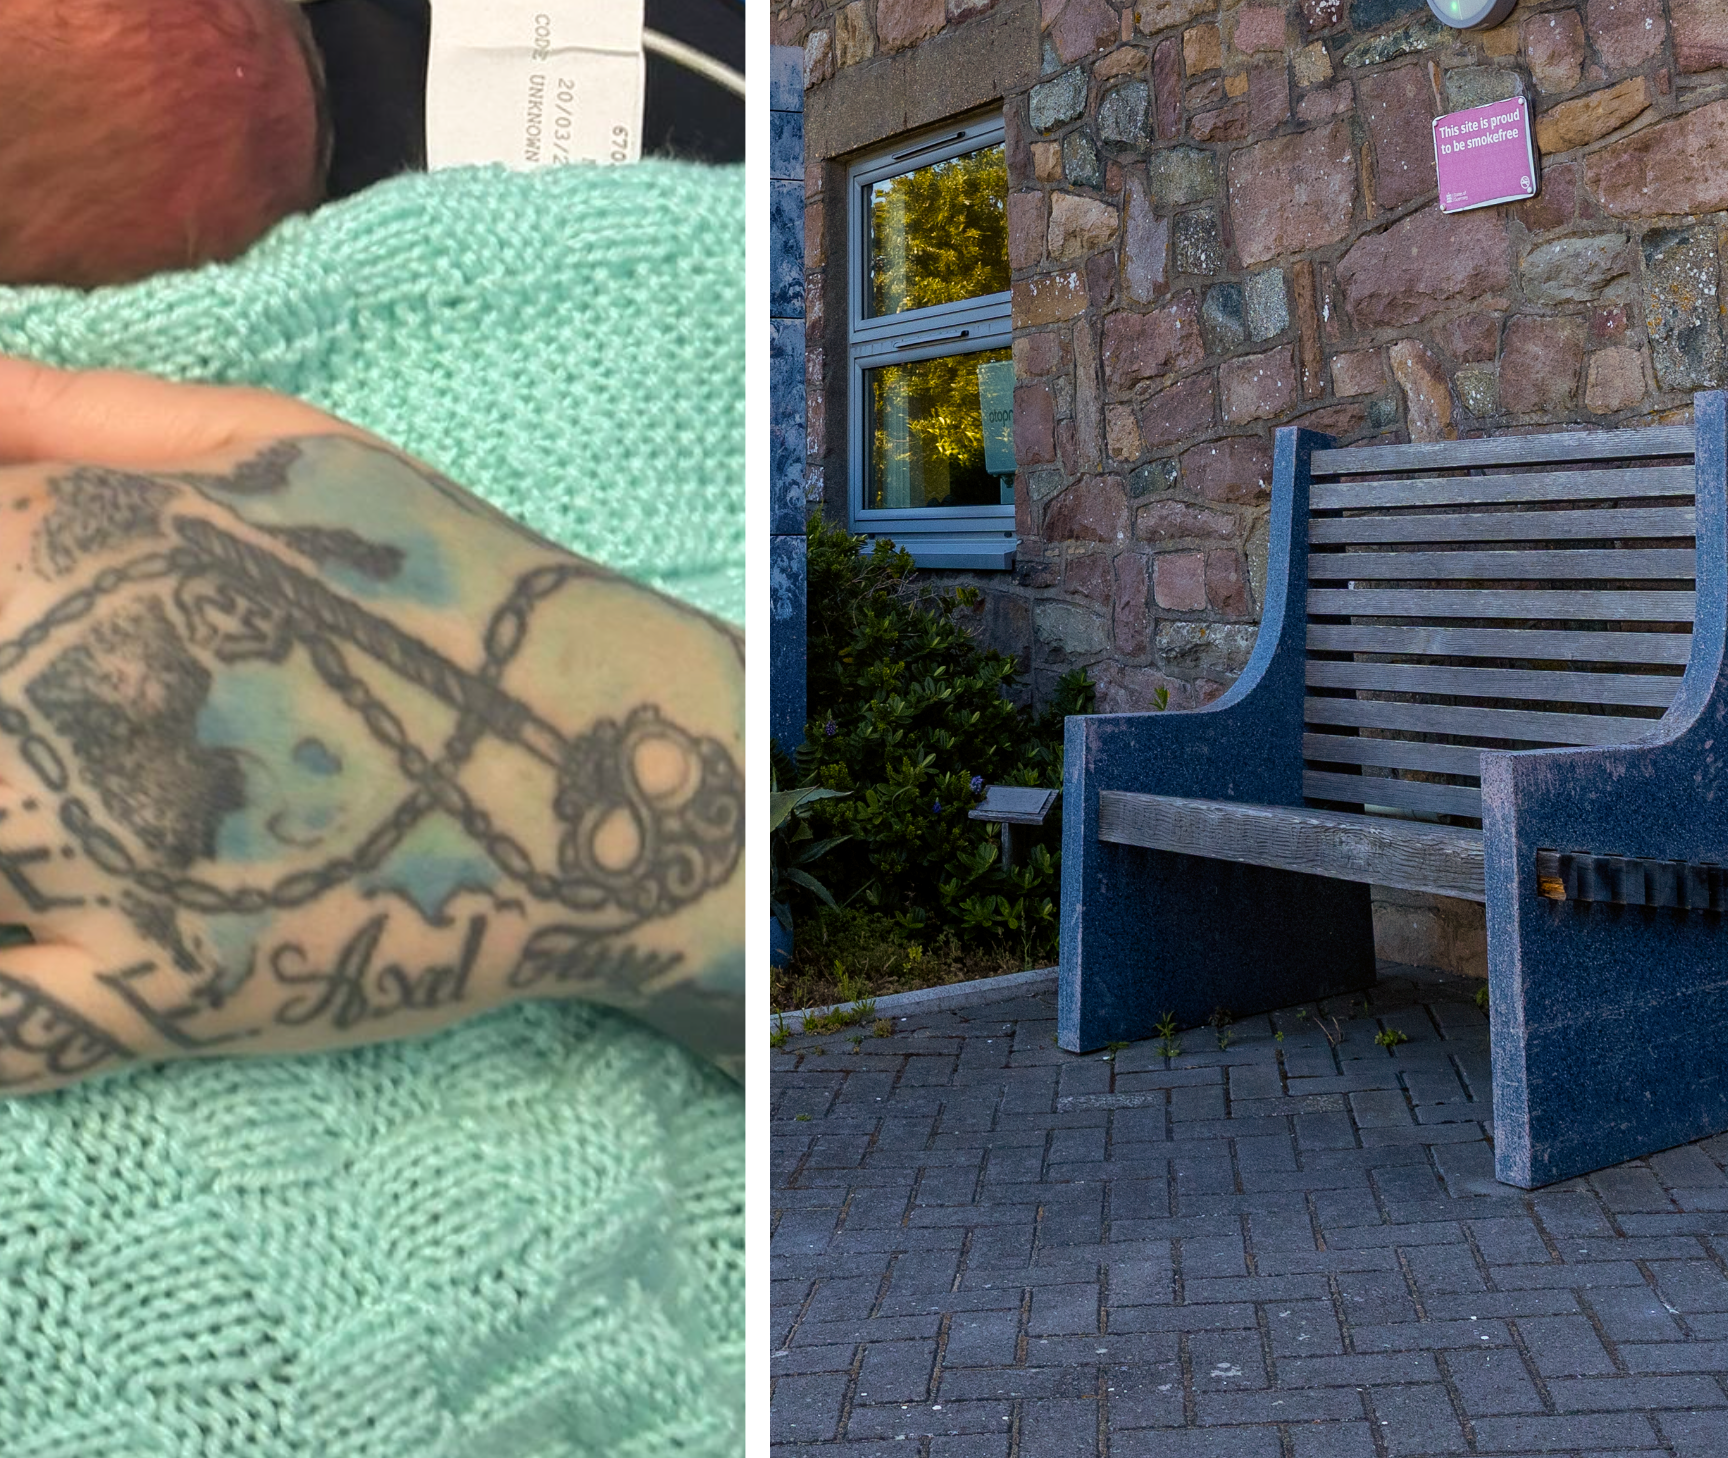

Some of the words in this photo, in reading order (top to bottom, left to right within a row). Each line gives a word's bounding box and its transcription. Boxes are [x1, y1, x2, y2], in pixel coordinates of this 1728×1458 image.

[532, 13, 551, 62] CODE
[525, 75, 546, 162] UNKNOWN
[1439, 124, 1459, 139] This
[1461, 120, 1478, 135] site
[1480, 117, 1489, 129] is
[1490, 108, 1520, 129] proud
[611, 126, 629, 167] 670
[1441, 144, 1451, 155] to
[1453, 140, 1465, 152] be
[1467, 128, 1519, 149] smokefree
